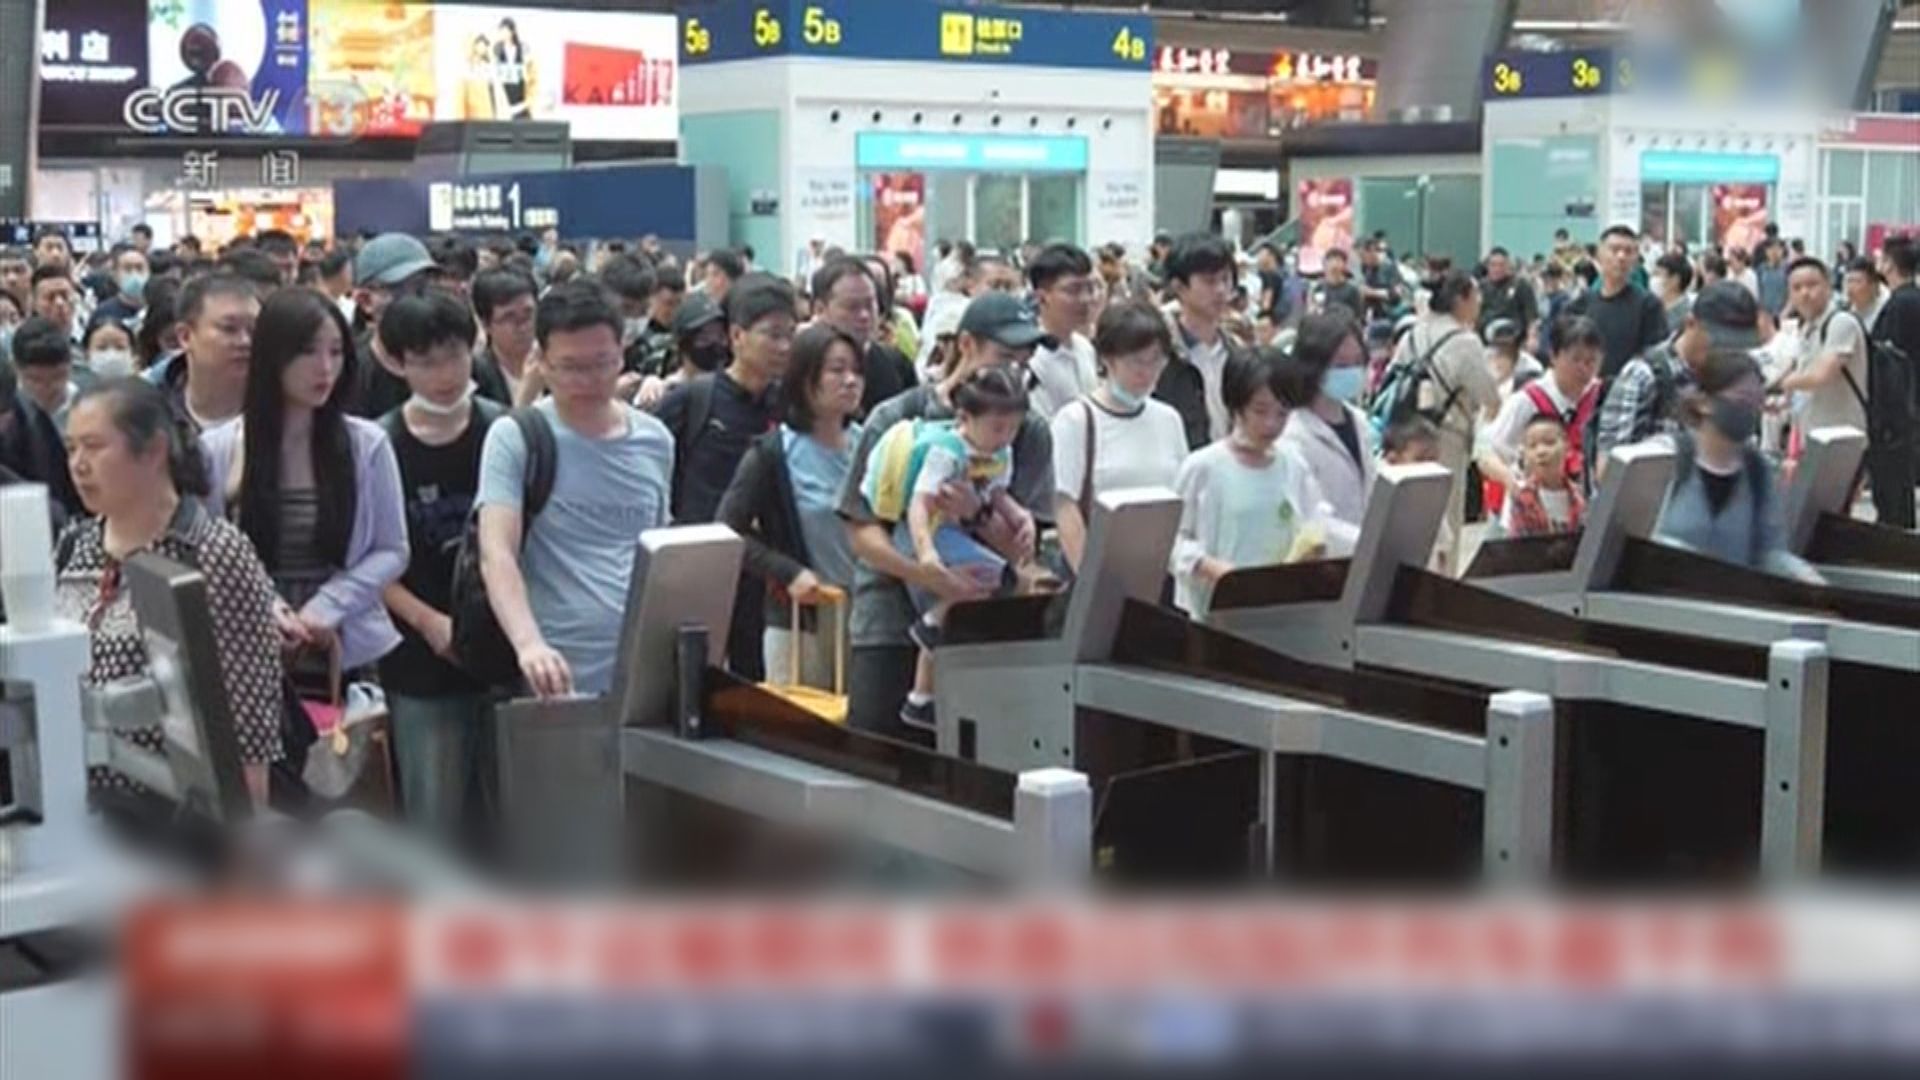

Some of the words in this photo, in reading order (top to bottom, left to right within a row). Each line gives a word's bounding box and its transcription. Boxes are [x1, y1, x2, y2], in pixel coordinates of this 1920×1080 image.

[685, 18, 710, 53] 5B
[756, 9, 781, 46] 5B
[804, 7, 841, 44] 5B
[1112, 26, 1145, 60] 4B
[507, 182, 520, 228] 1
